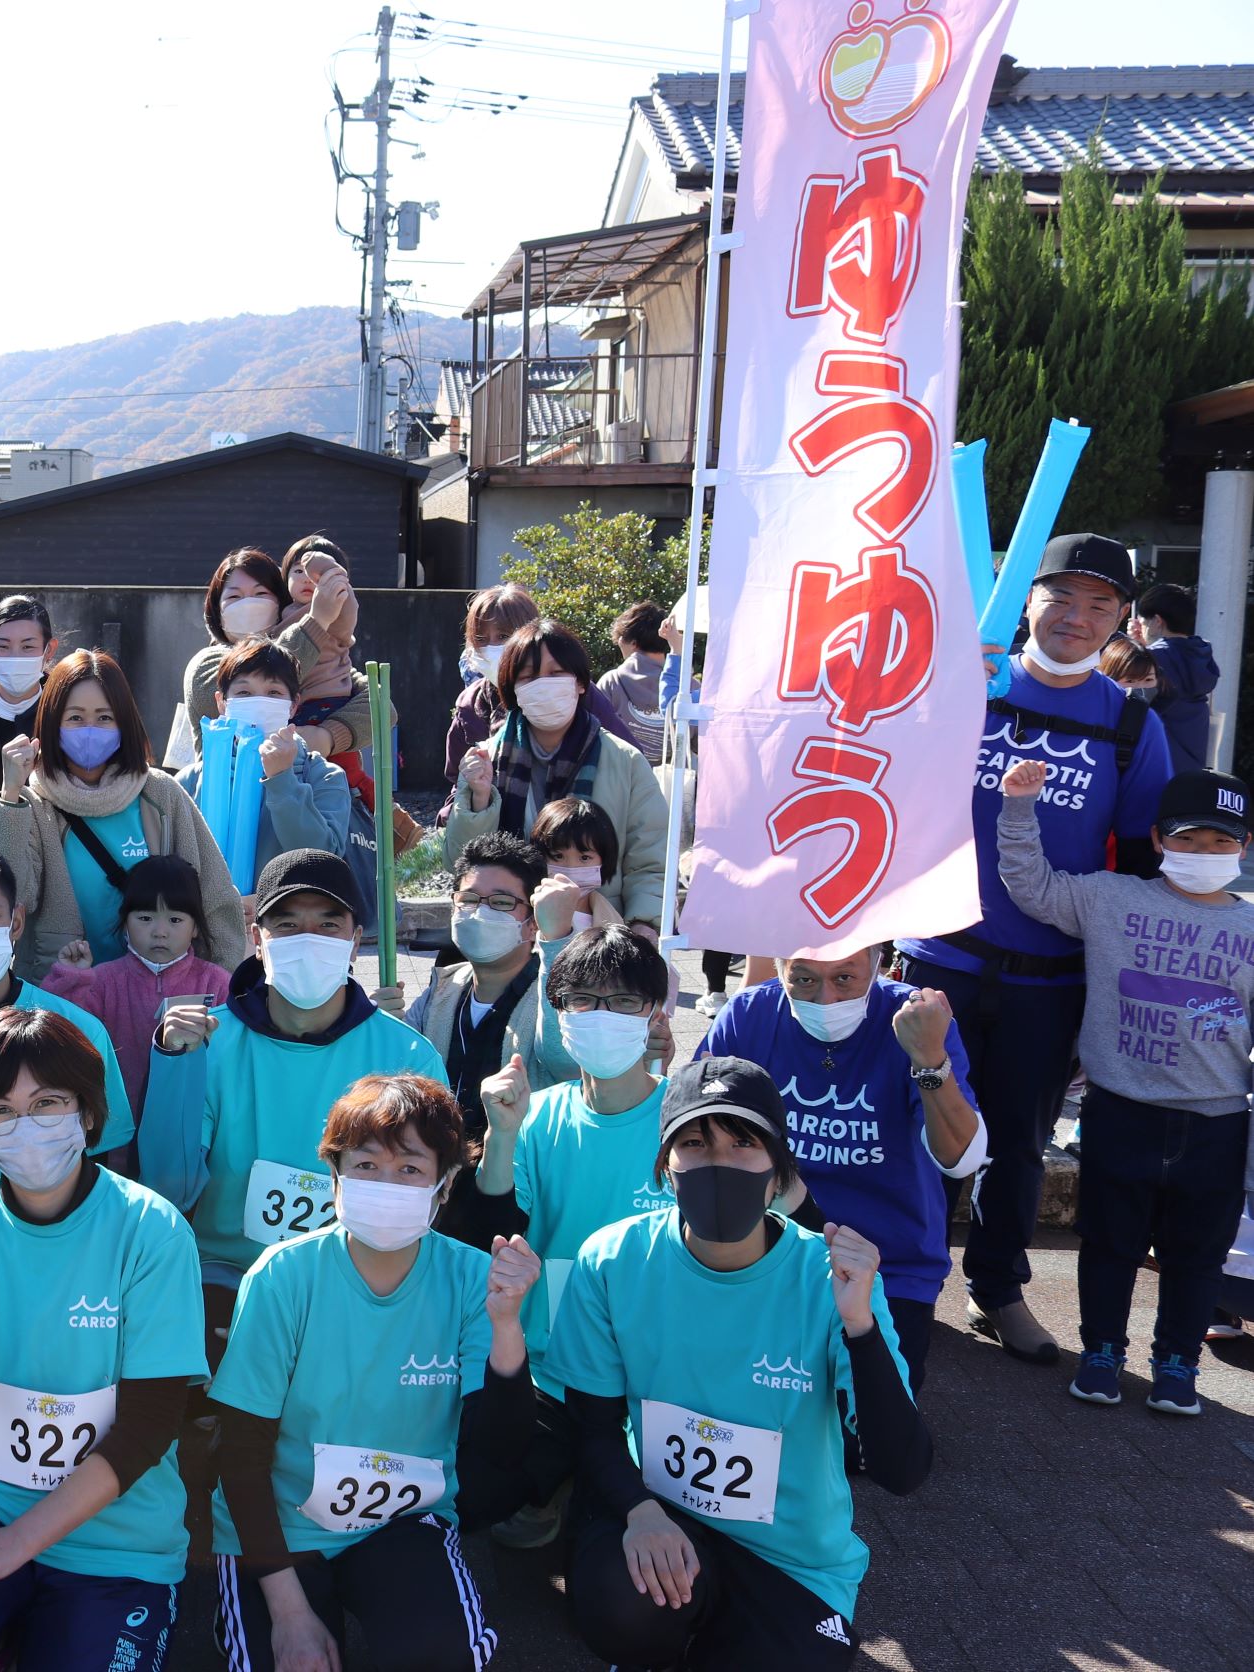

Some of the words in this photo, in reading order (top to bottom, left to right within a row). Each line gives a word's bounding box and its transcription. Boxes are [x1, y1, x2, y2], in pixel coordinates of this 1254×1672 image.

[766, 143, 938, 929] ゆうゆう
[1217, 788, 1244, 812] DUO
[122, 848, 149, 857] CARE
[1124, 912, 1202, 947] SLOW
[1134, 943, 1241, 985] STEADY
[1119, 999, 1178, 1036] WINS
[1117, 1029, 1181, 1066] RACE
[786, 1110, 879, 1141] AREOTH
[787, 1137, 885, 1165] LDINGS
[262, 1189, 338, 1233] 322
[69, 1315, 118, 1329] CAREO
[752, 1372, 813, 1393] CAREOH
[10, 1418, 97, 1468] 322
[31, 1472, 74, 1486] キャレオ
[664, 1434, 754, 1499] 322
[329, 1476, 422, 1520] 322
[681, 1490, 722, 1513] キャレオス
